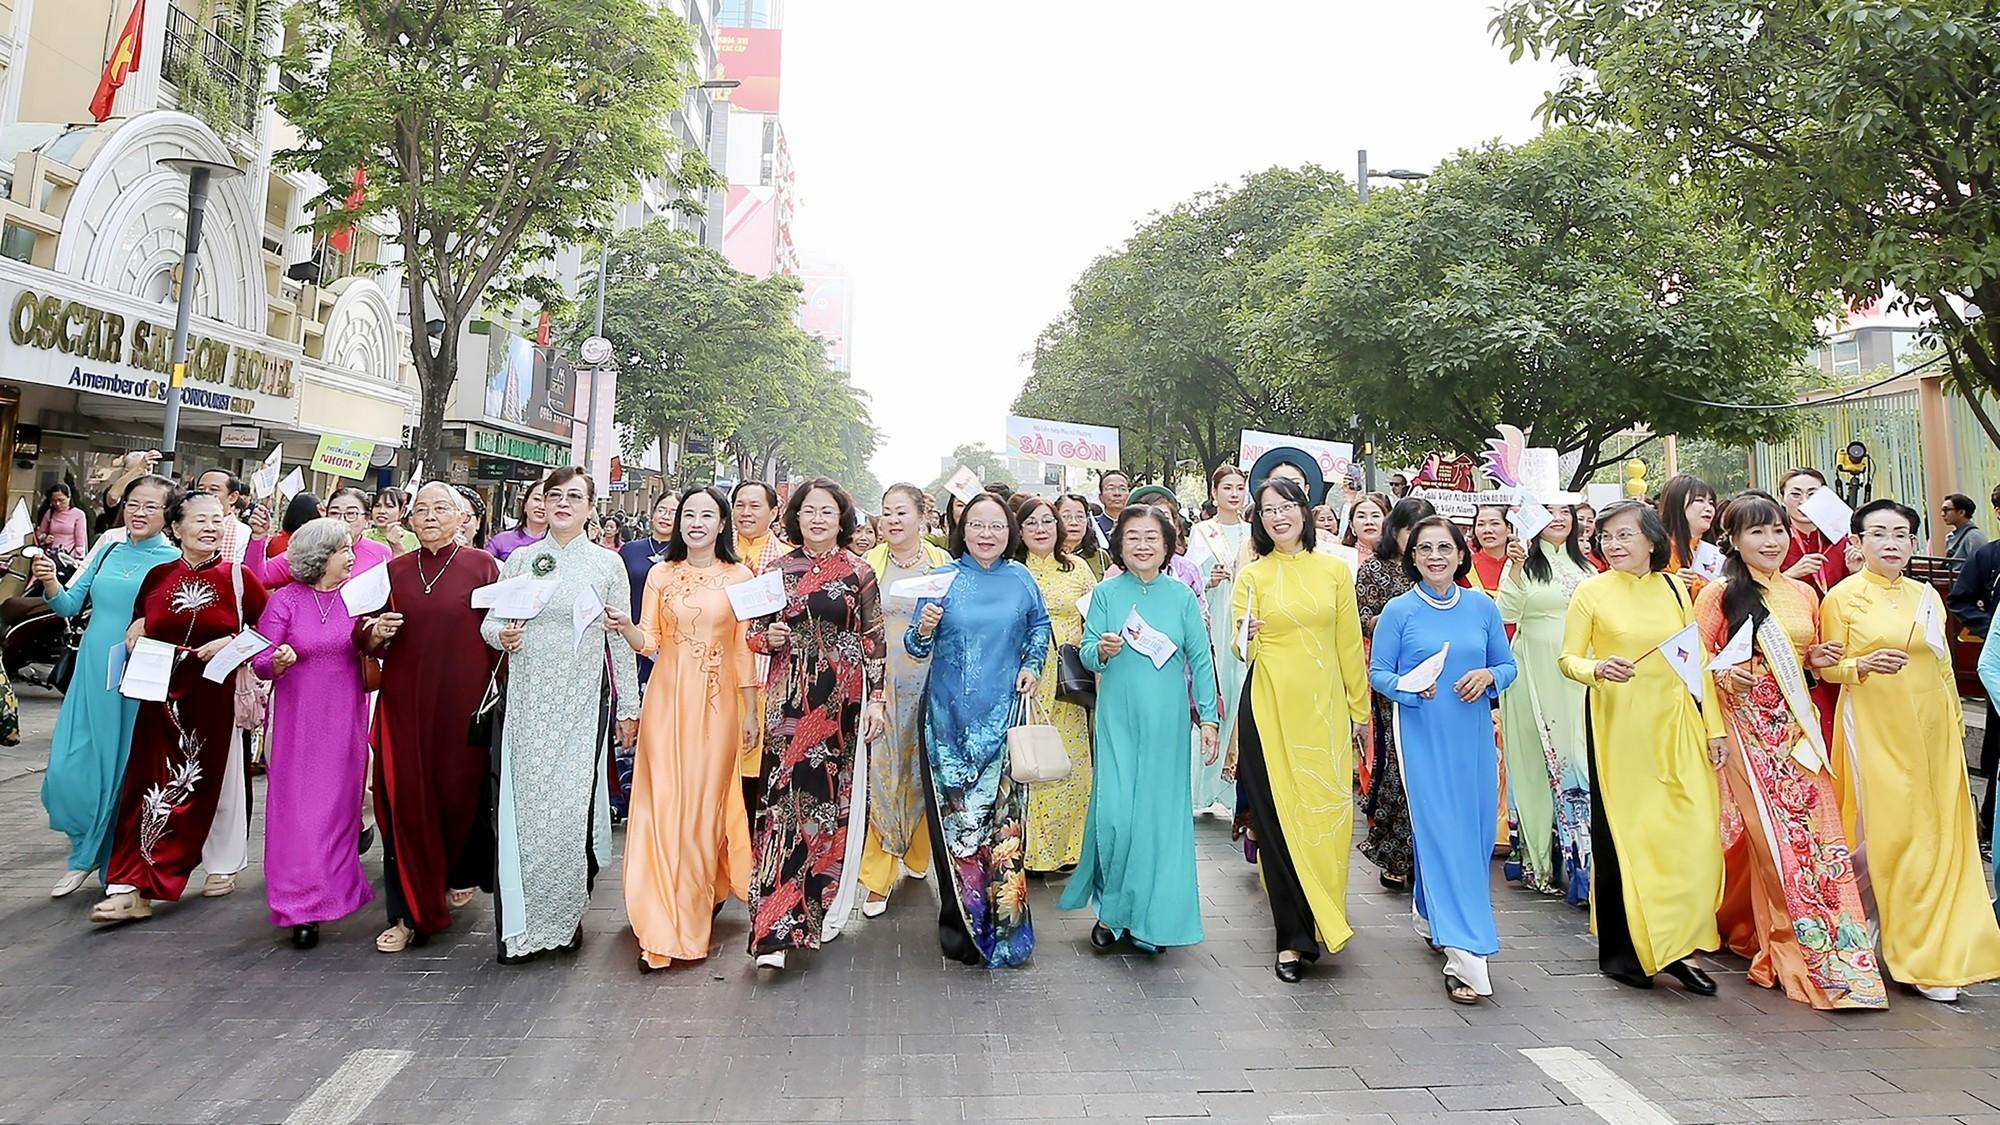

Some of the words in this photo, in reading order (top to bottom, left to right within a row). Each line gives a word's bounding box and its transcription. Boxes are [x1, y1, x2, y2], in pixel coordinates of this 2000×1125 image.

[10, 289, 125, 363] OSCAR
[230, 346, 295, 399] HOTEL
[68, 366, 81, 386] A
[82, 372, 135, 394] member
[134, 379, 149, 396] of
[1019, 432, 1054, 456] SÀI
[1058, 438, 1106, 462] GÒN
[354, 461, 362, 471] 2
[1455, 505, 1474, 513] Nam
